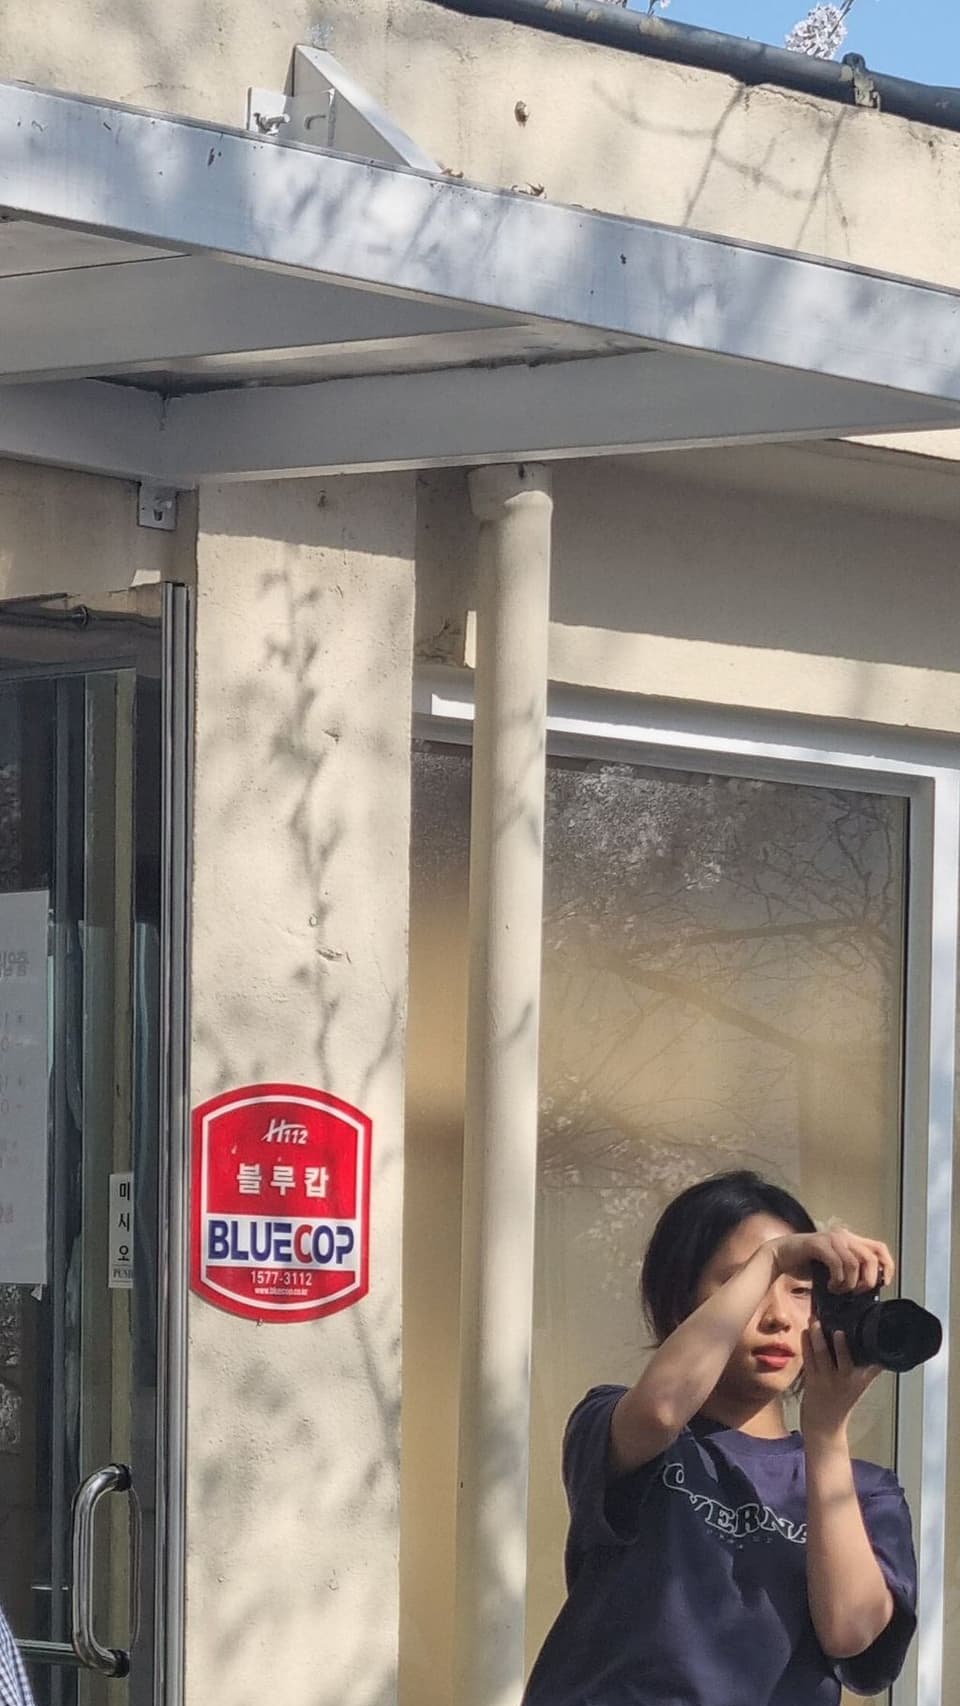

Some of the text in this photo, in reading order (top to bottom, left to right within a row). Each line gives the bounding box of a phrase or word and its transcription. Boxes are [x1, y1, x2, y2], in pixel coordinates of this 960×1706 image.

[237, 1163, 329, 1198] 블루캅
[118, 1182, 131, 1262] 미시오
[207, 1219, 354, 1265] BLUECOP
[250, 1270, 313, 1286] 1577-3112
